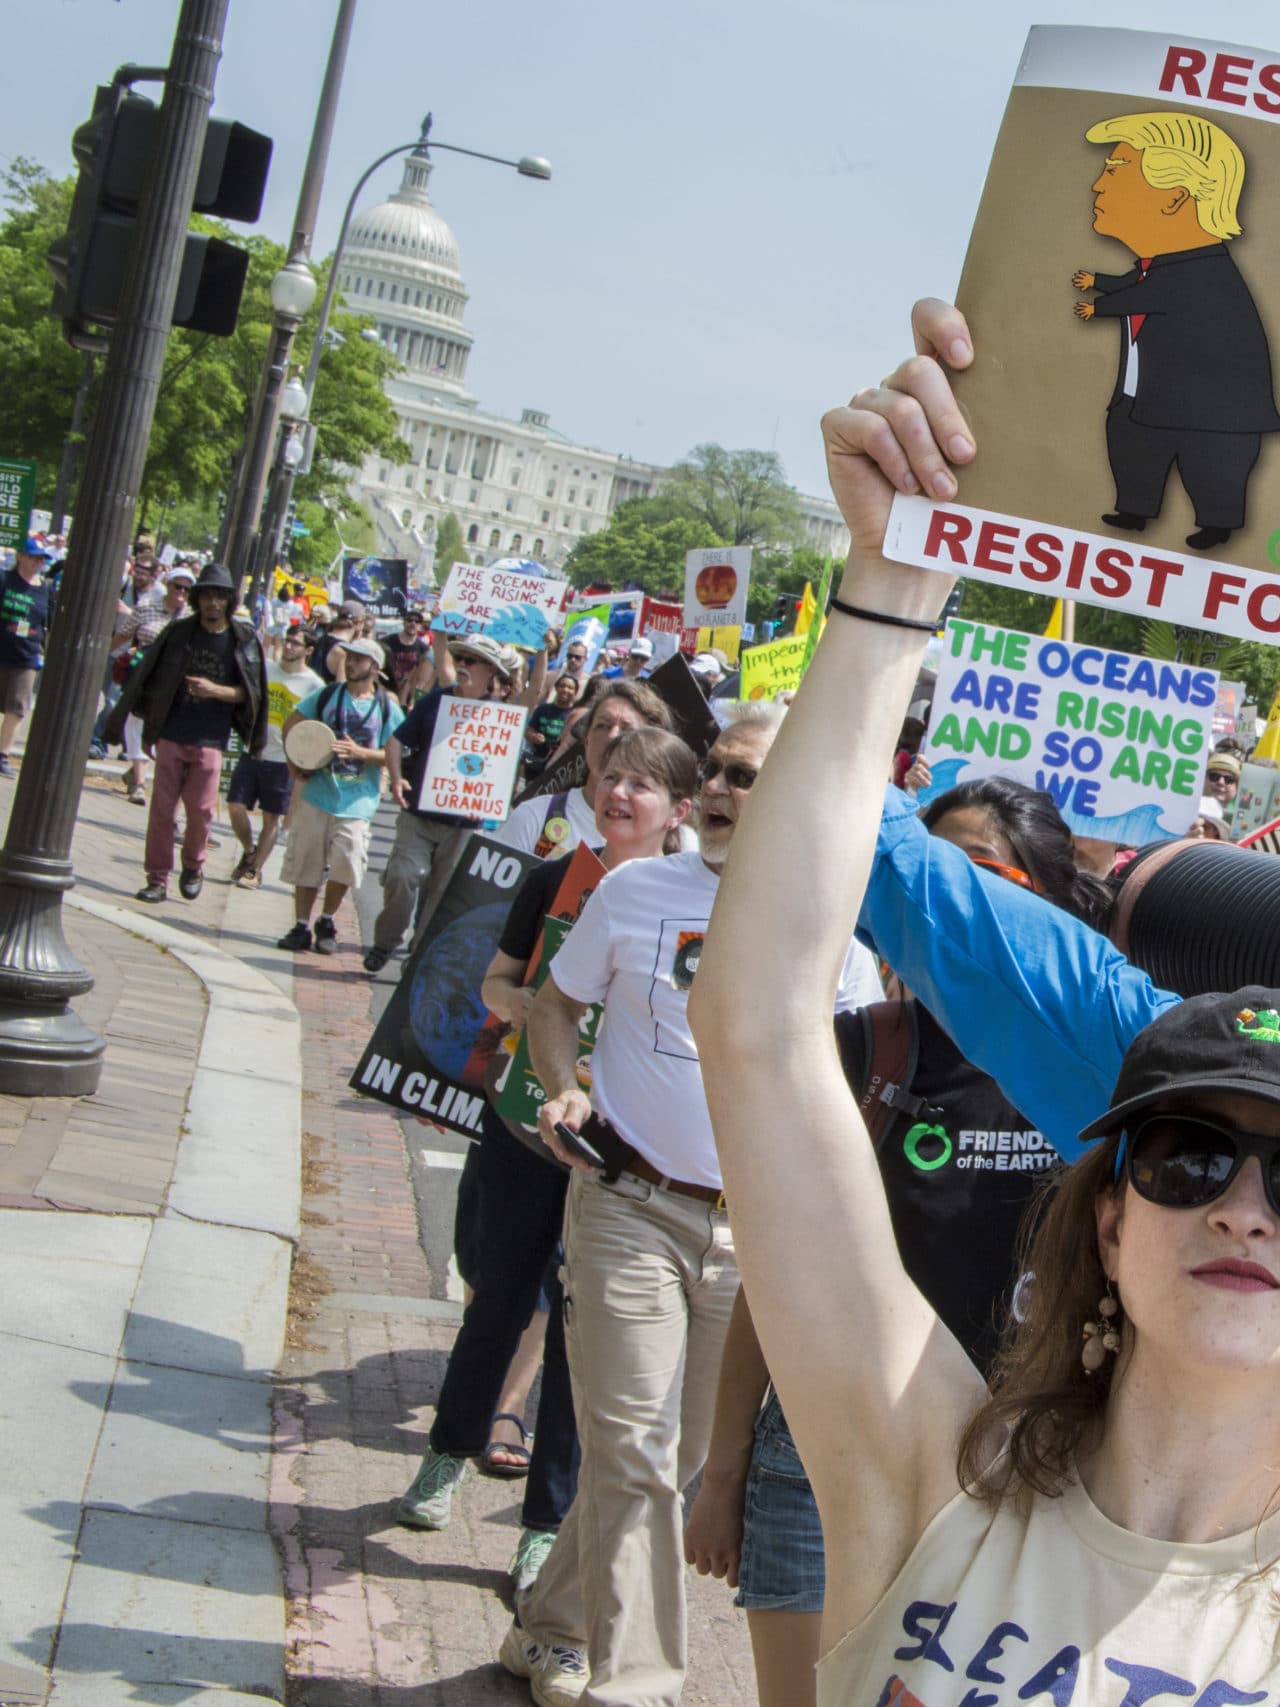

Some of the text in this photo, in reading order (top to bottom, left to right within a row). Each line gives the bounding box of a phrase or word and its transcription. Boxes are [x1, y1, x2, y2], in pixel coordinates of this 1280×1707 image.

[923, 509, 1184, 609] RESIST
[457, 566, 548, 594] THE OCEANS
[458, 579, 483, 592] ARE
[490, 587, 539, 605] RISING
[458, 590, 479, 603] SO
[464, 603, 492, 619] ARE
[442, 615, 487, 634] WE!
[948, 619, 1216, 707] THE OCEANS
[449, 703, 522, 727] KEEP THE
[951, 669, 1042, 720] ARE
[1056, 691, 1204, 755] RISING
[453, 721, 511, 742] EARTH
[448, 736, 508, 757] CLEAN
[931, 713, 1200, 796] AND SO ARE
[432, 777, 495, 798] IT'S NOT
[1035, 770, 1101, 817] WE
[434, 794, 504, 816] URANUS
[469, 845, 522, 889] NO
[360, 1054, 485, 1134] IN CLIM
[956, 1154, 973, 1169] of
[974, 1154, 994, 1169] the
